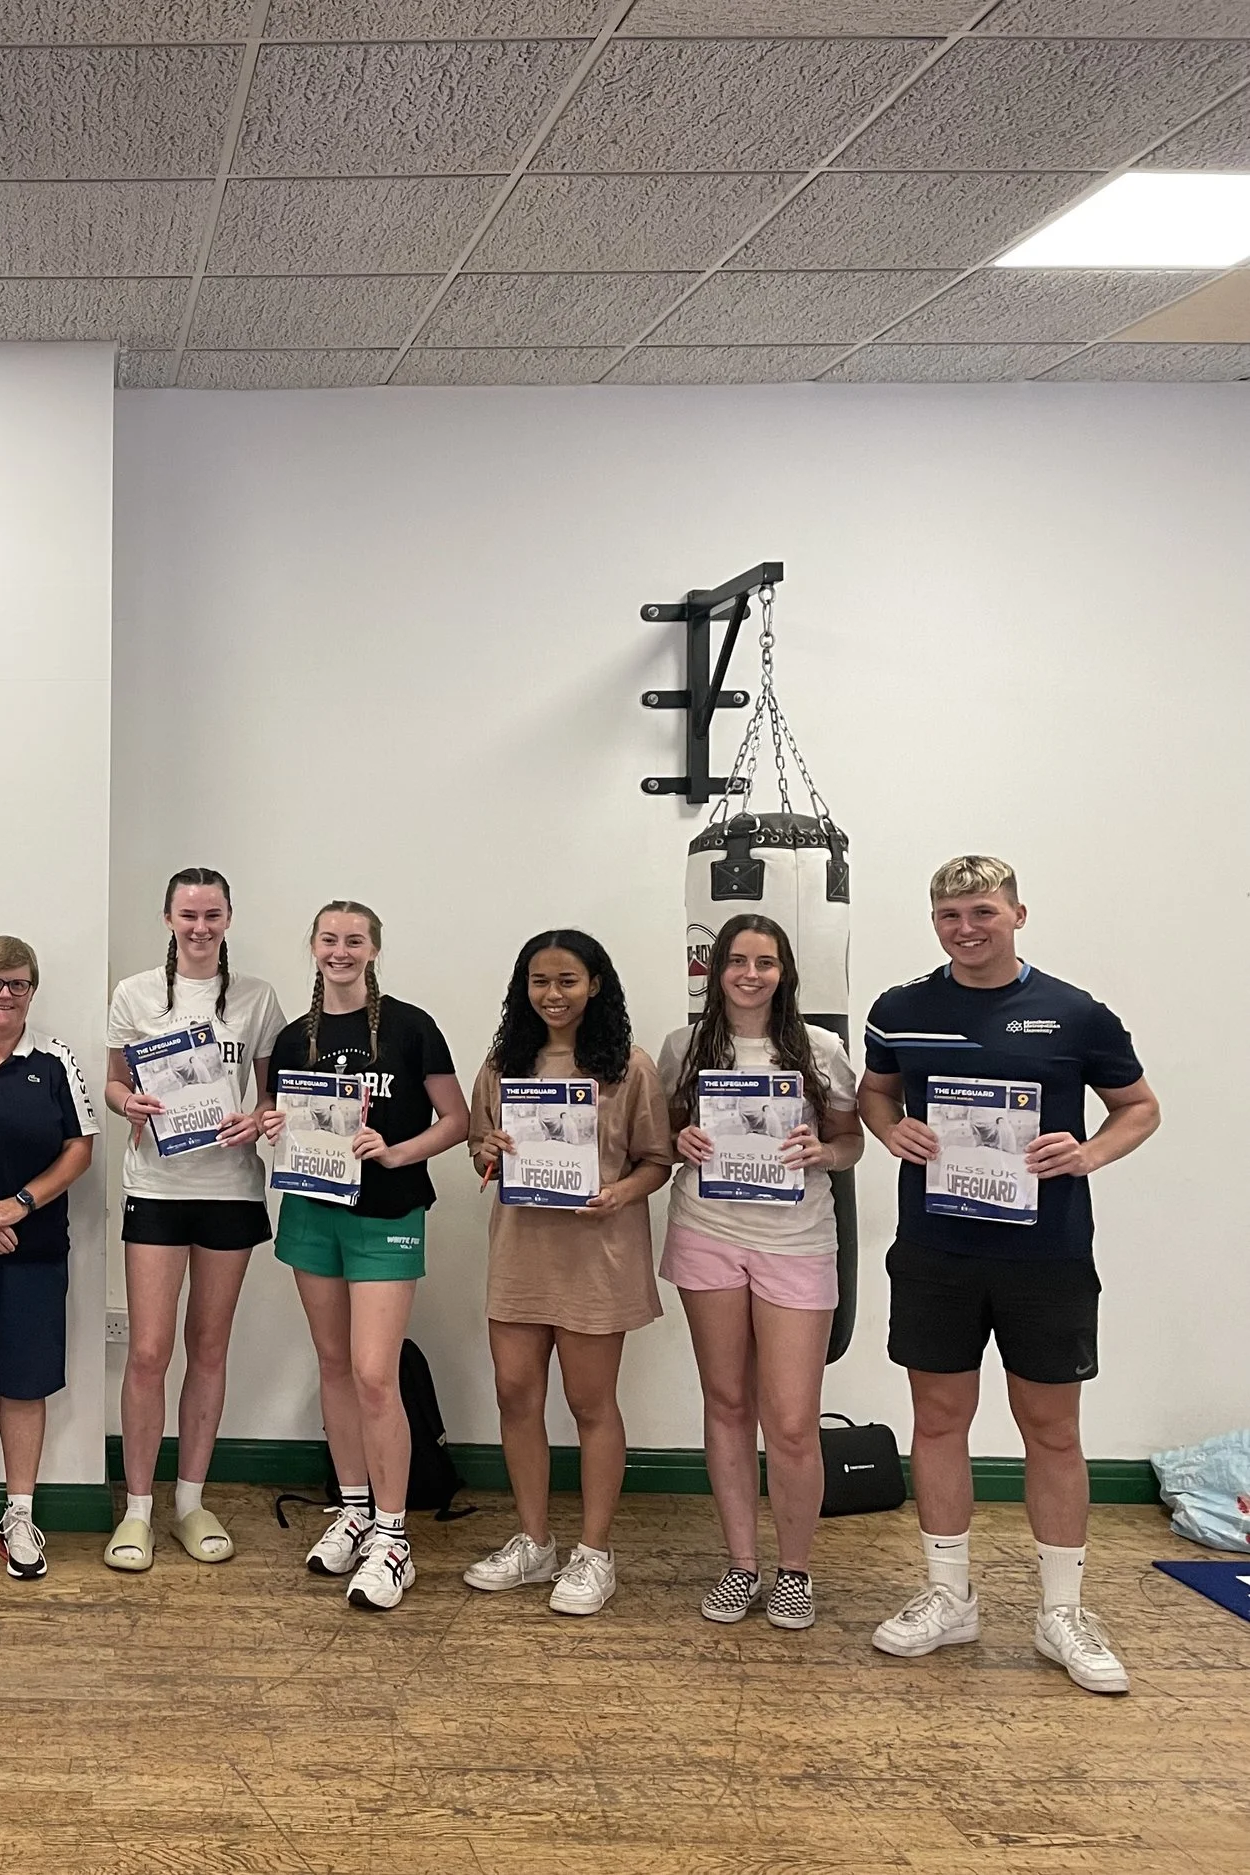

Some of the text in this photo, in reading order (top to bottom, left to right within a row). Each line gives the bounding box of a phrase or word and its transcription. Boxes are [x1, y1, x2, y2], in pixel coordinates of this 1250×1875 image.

[197, 1032, 207, 1043] 9
[136, 1046, 149, 1055] THE
[149, 1038, 182, 1053] LIFEGUARD
[294, 1079, 328, 1088] LIFEGUARD
[344, 1084, 354, 1096] 9
[779, 1081, 790, 1095] 9
[575, 1089, 586, 1102] 9
[934, 1087, 950, 1095] THE
[950, 1088, 995, 1098] LIFEGUARD
[199, 1097, 220, 1107] UK
[1017, 1094, 1029, 1107] 9
[169, 1106, 224, 1134] LIFEGUARD
[325, 1149, 346, 1158] UK
[290, 1153, 346, 1179] LIFEGUARD
[558, 1160, 582, 1169] UK
[521, 1167, 582, 1191] LIFEGUARD
[720, 1161, 786, 1184] LIFEGUARD
[990, 1169, 1018, 1179] UK
[946, 1173, 1017, 1203] LIFEGUARD
